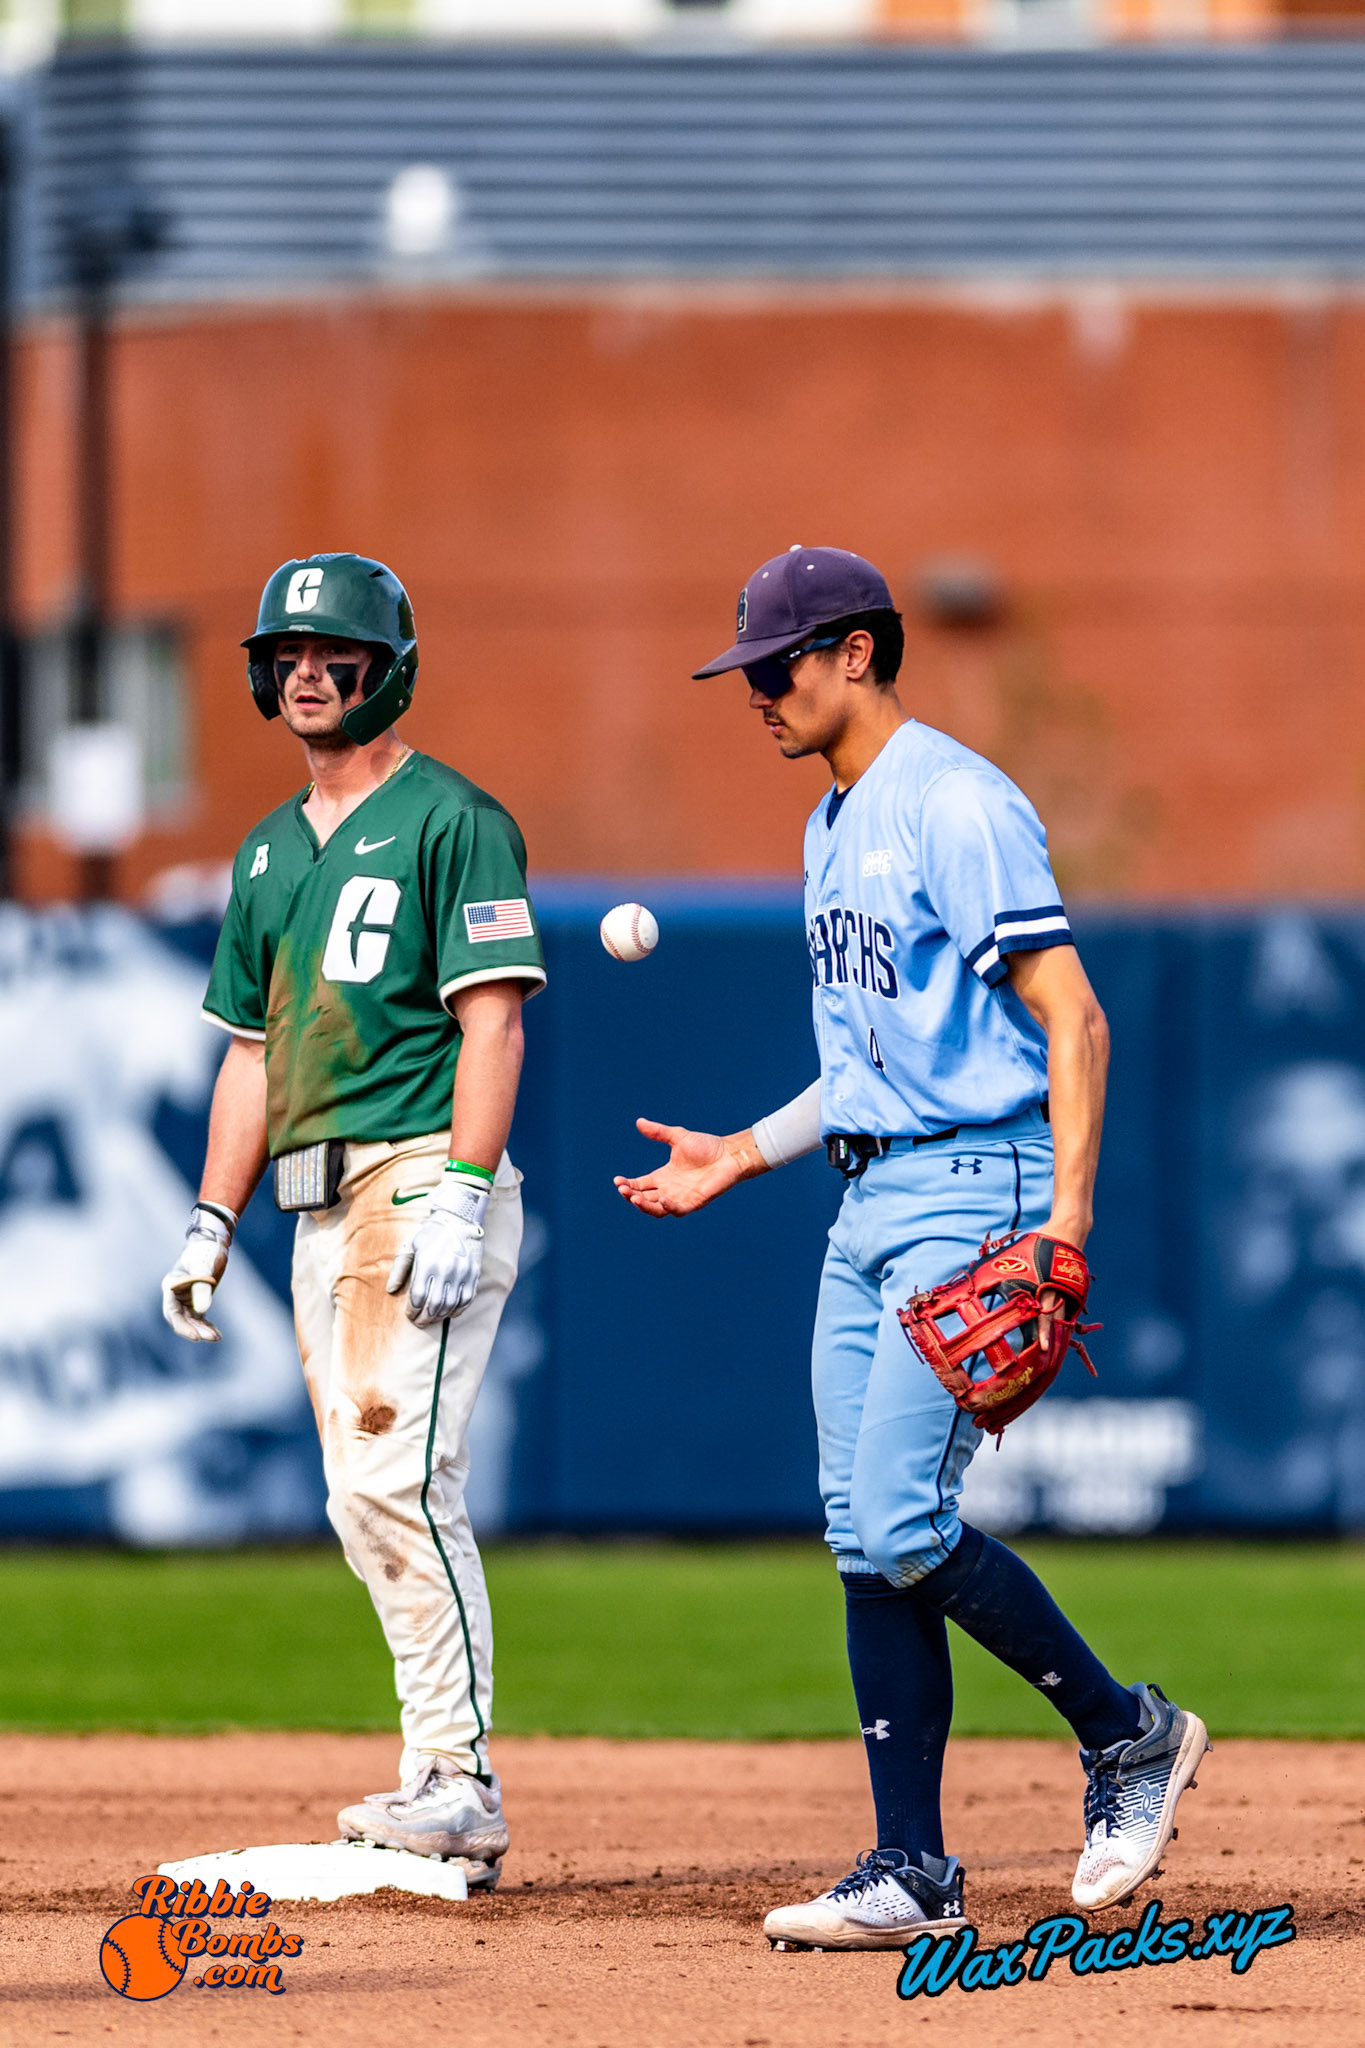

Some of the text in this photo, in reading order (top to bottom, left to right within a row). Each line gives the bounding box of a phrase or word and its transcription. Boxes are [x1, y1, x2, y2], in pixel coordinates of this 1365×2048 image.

[285, 567, 325, 614] C
[320, 874, 405, 987] C
[807, 908, 899, 1000] ARCHS
